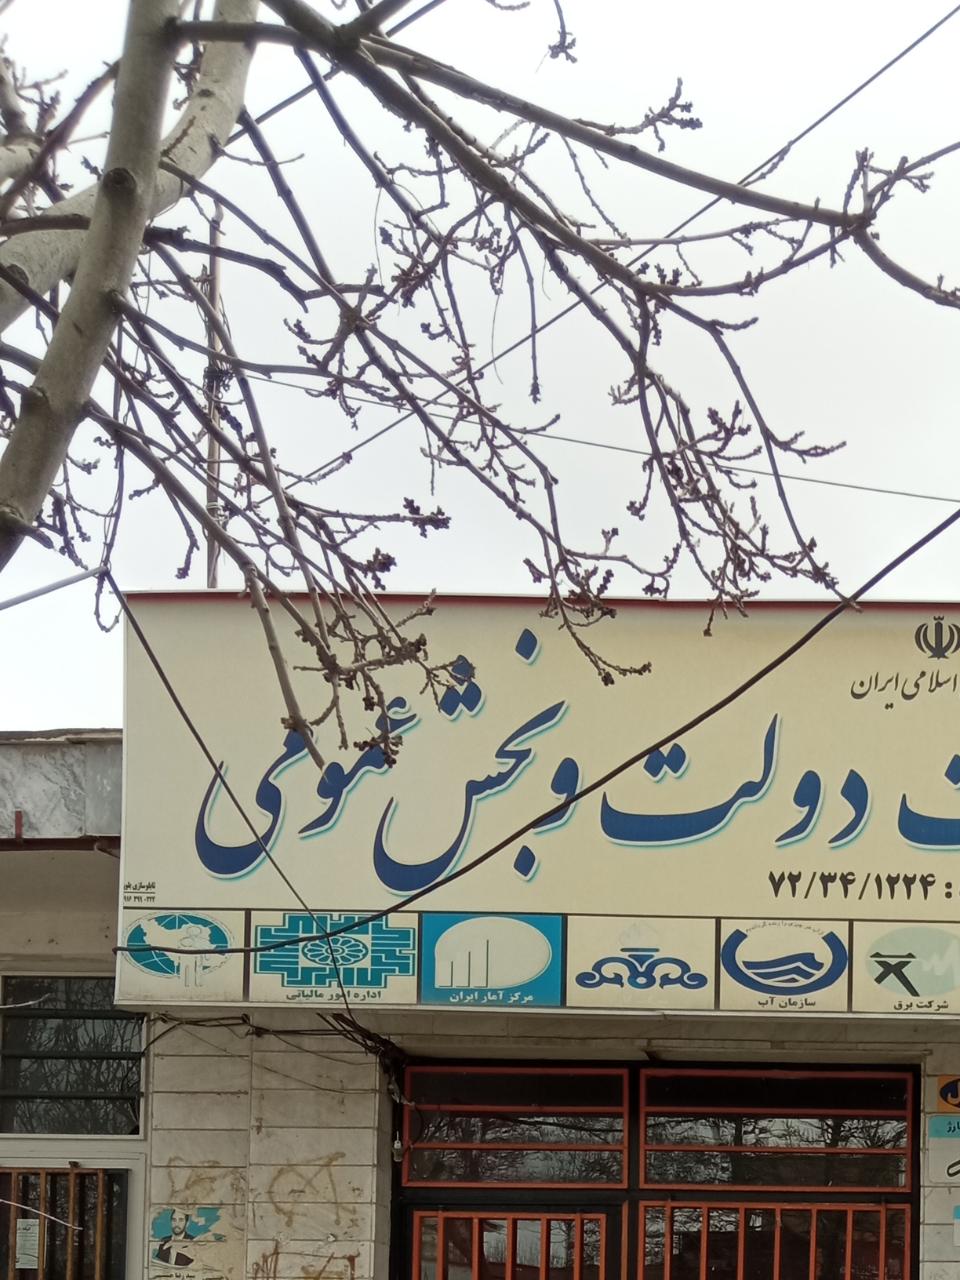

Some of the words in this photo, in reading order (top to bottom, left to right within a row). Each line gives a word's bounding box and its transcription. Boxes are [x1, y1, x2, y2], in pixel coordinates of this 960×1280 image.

[850, 671, 900, 710] ایران
[900, 669, 958, 701] اسلامی
[372, 628, 567, 895] بخش
[601, 712, 871, 845] دولت
[195, 696, 418, 877] عمومی
[532, 754, 584, 830] و
[353, 990, 382, 1001] اداره
[449, 991, 479, 1003] ایران
[480, 990, 505, 1004] آمار
[507, 991, 534, 1004] مرکز
[757, 996, 776, 1008] آب
[778, 998, 817, 1009] سازمان
[893, 1000, 913, 1011] برق
[916, 1000, 949, 1011] شرکت
